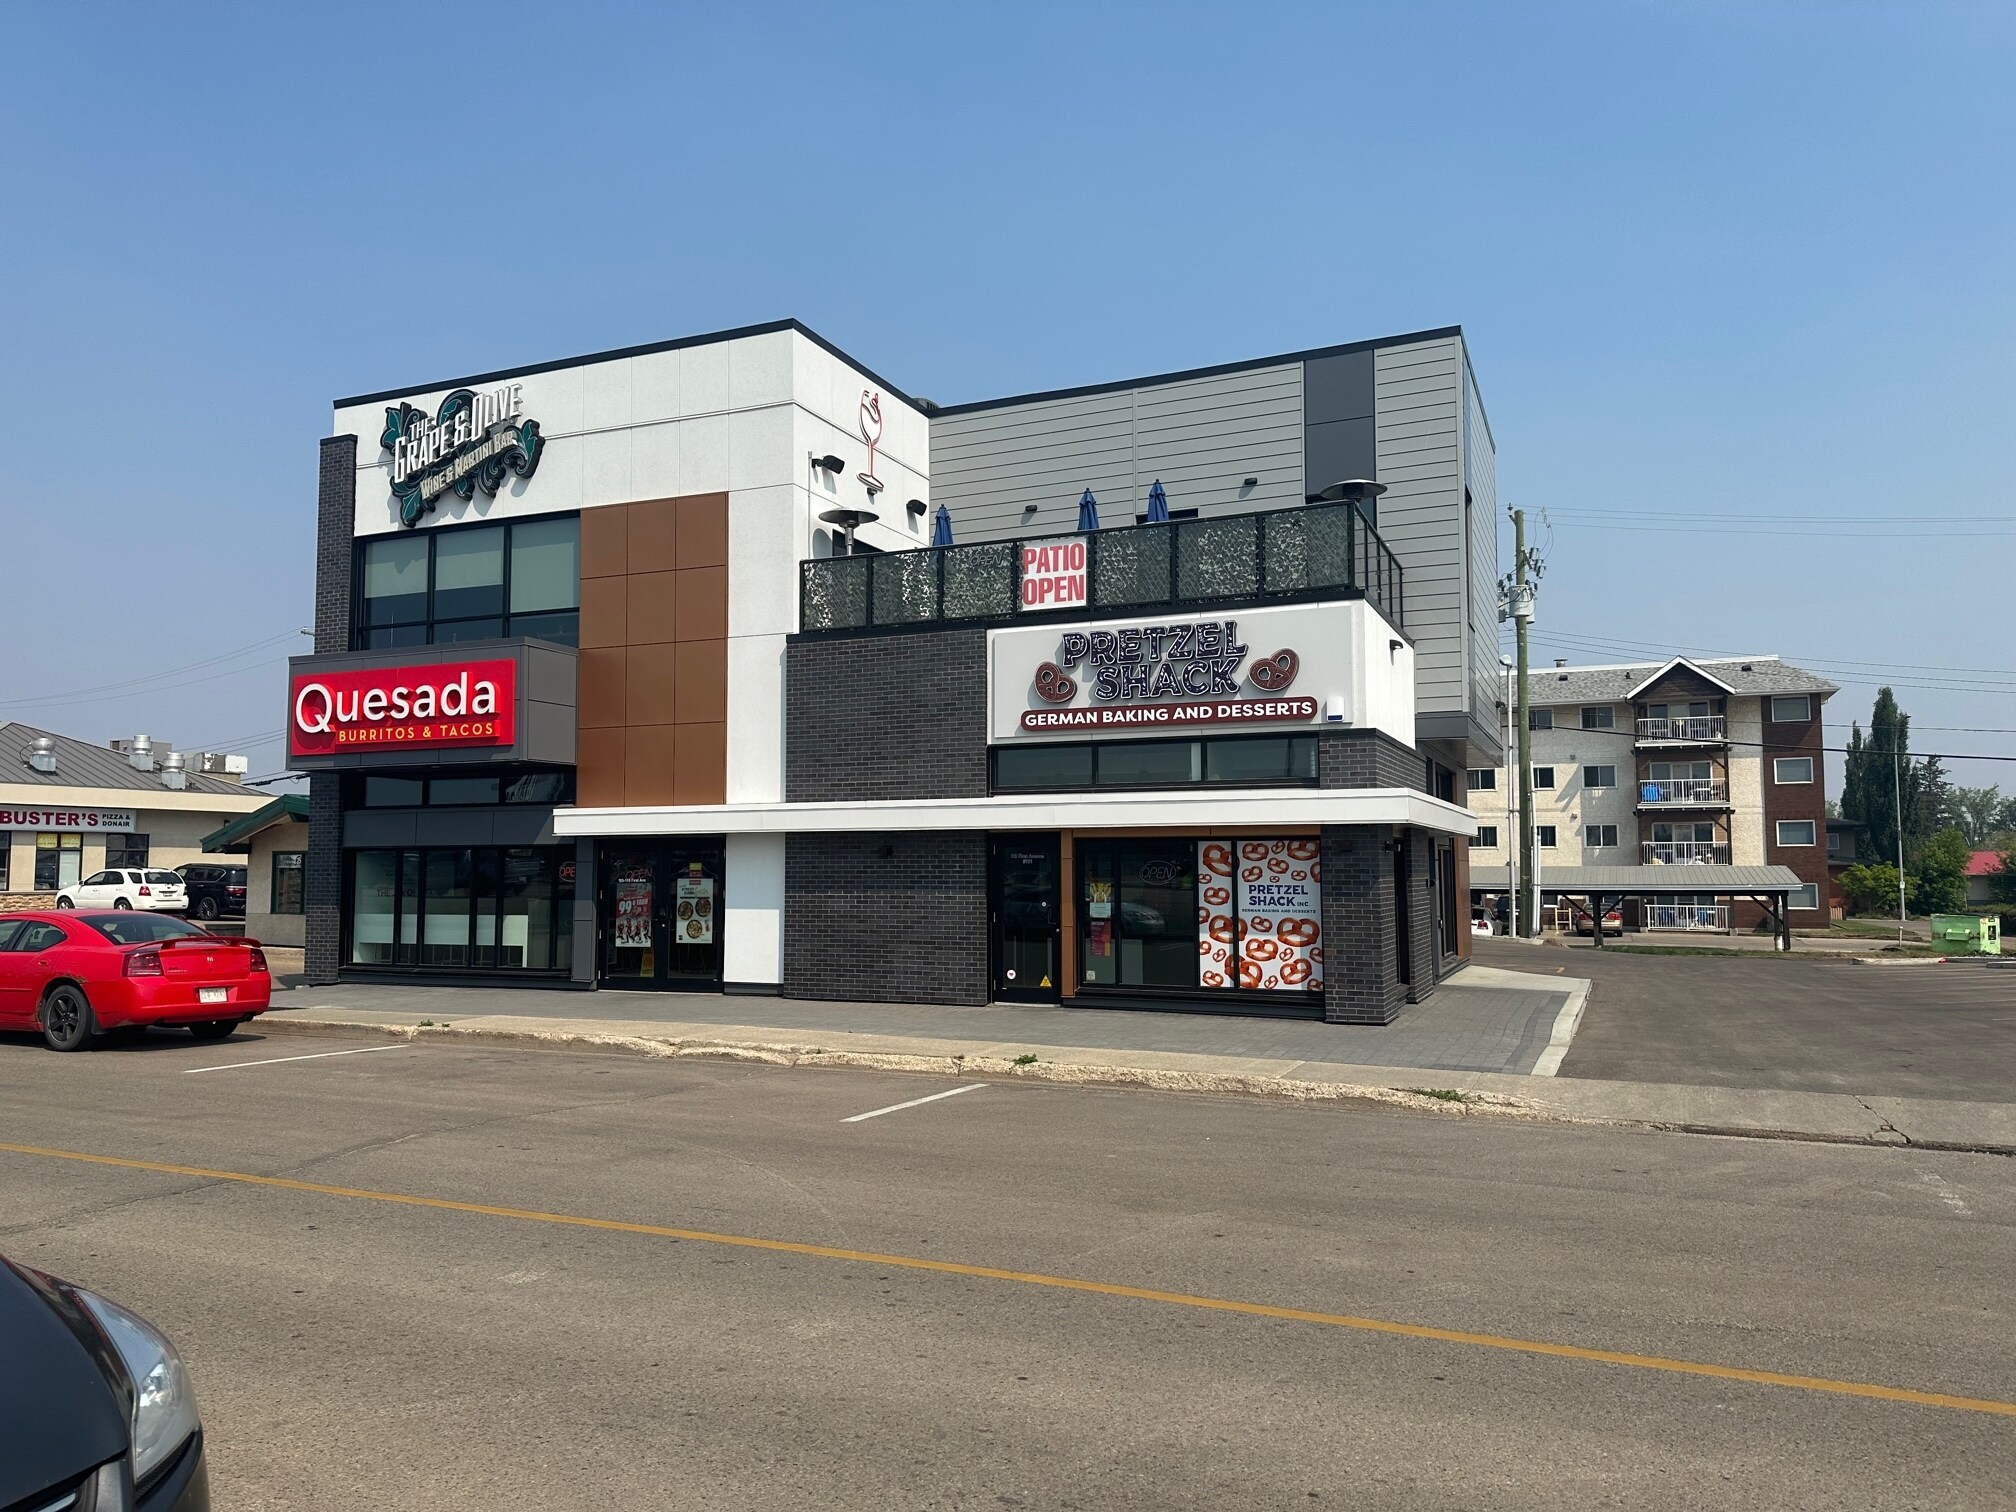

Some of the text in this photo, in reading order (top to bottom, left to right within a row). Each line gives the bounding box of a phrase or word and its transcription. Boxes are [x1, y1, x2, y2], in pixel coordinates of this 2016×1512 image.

[394, 383, 523, 483] GRAPE & OLIVE
[410, 419, 433, 441] THE
[420, 430, 516, 499] WINE & MARTINI BAR
[1023, 542, 1084, 575] PATIO
[1023, 574, 1084, 606] OPEN
[1062, 620, 1248, 667] PRETZEL
[1094, 657, 1240, 701] SHACK
[296, 672, 496, 733] Quesada
[1025, 701, 1312, 727] GERMAN BAKING AND DESSERTS
[339, 722, 493, 742] BURRITOS & TACOS
[0, 810, 99, 827] BUSTER'S
[559, 866, 575, 878] OPE
[1141, 865, 1173, 879] OPEN
[1249, 885, 1308, 895] PRETZEL
[1249, 896, 1296, 907] SHACK
